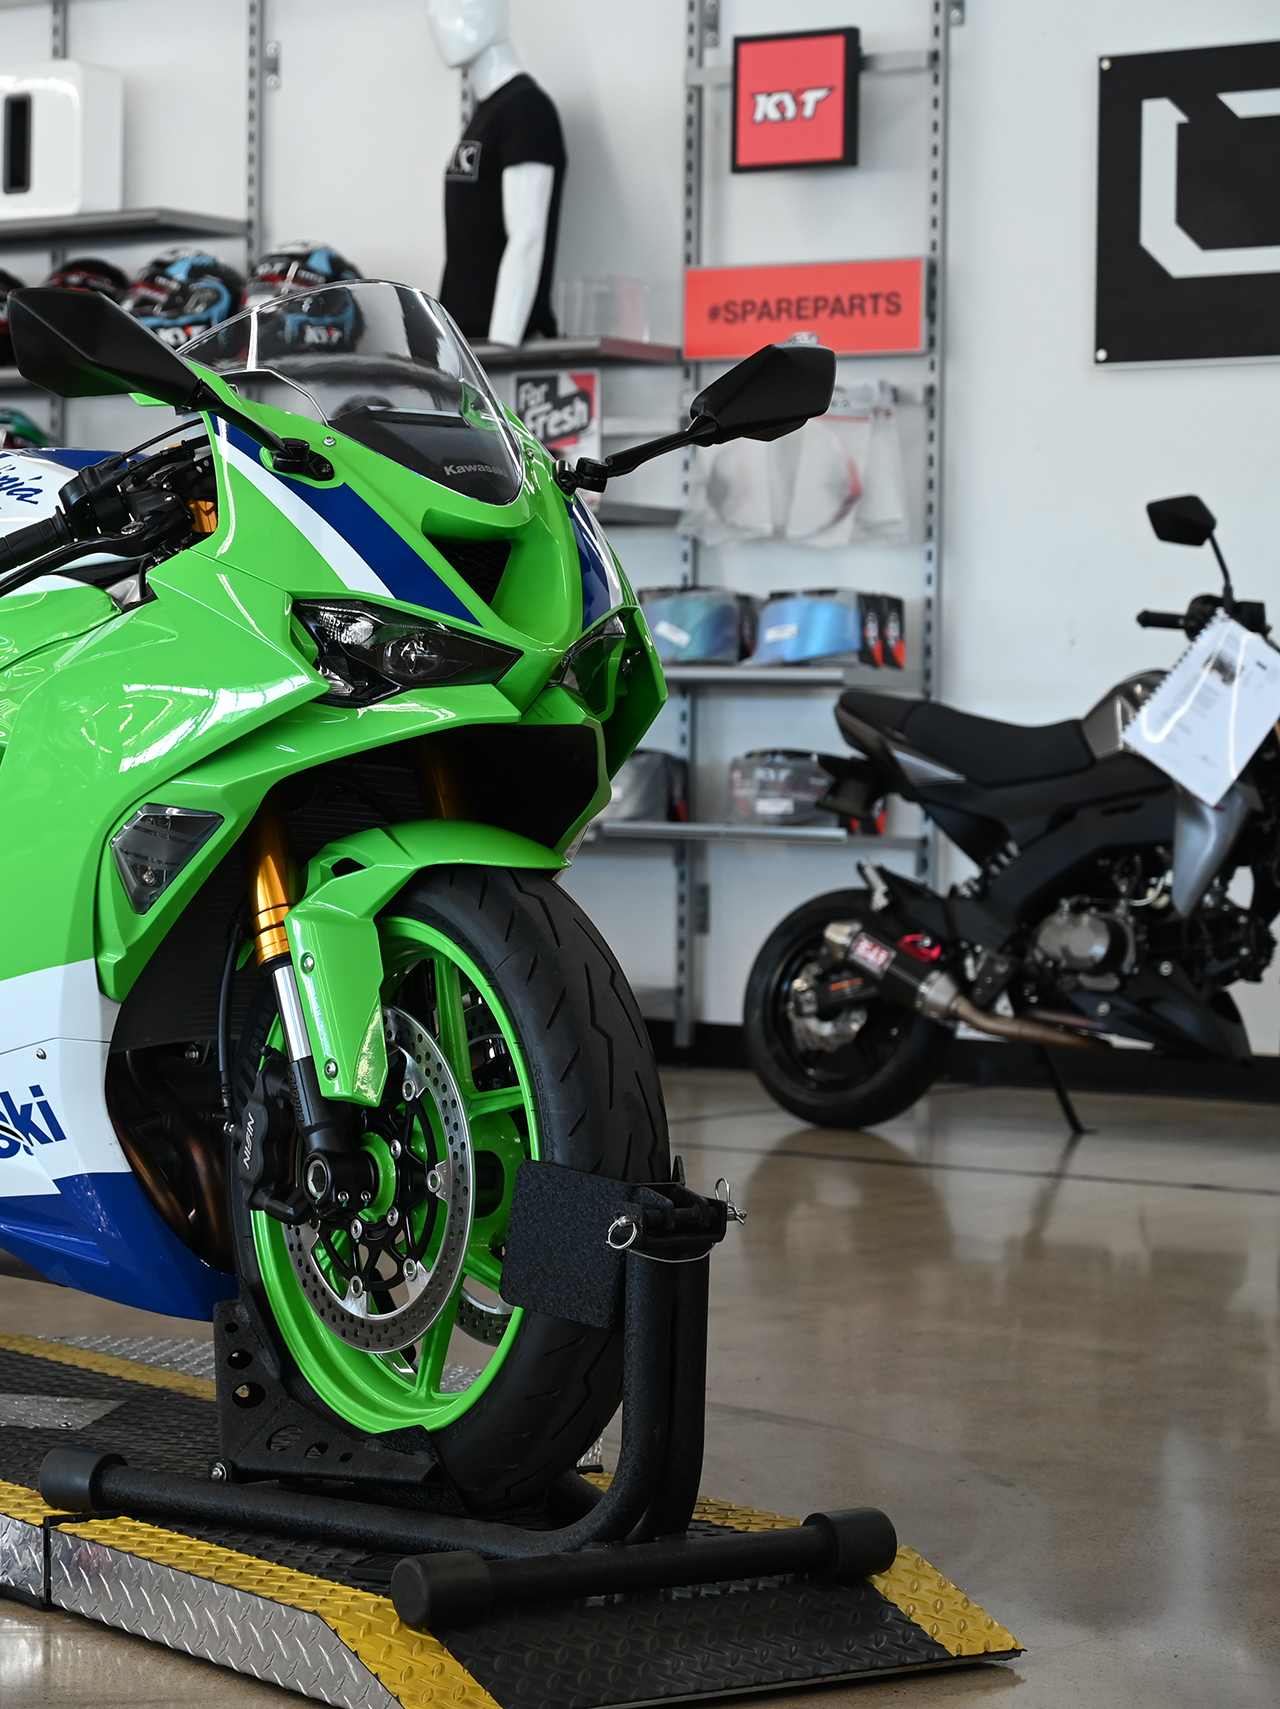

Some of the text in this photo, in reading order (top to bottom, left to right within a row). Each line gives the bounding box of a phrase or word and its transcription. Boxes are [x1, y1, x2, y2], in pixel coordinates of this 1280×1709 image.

[751, 87, 834, 123] KYT
[708, 291, 902, 324] #SPAREPARTS
[443, 464, 509, 478] Kawasaki
